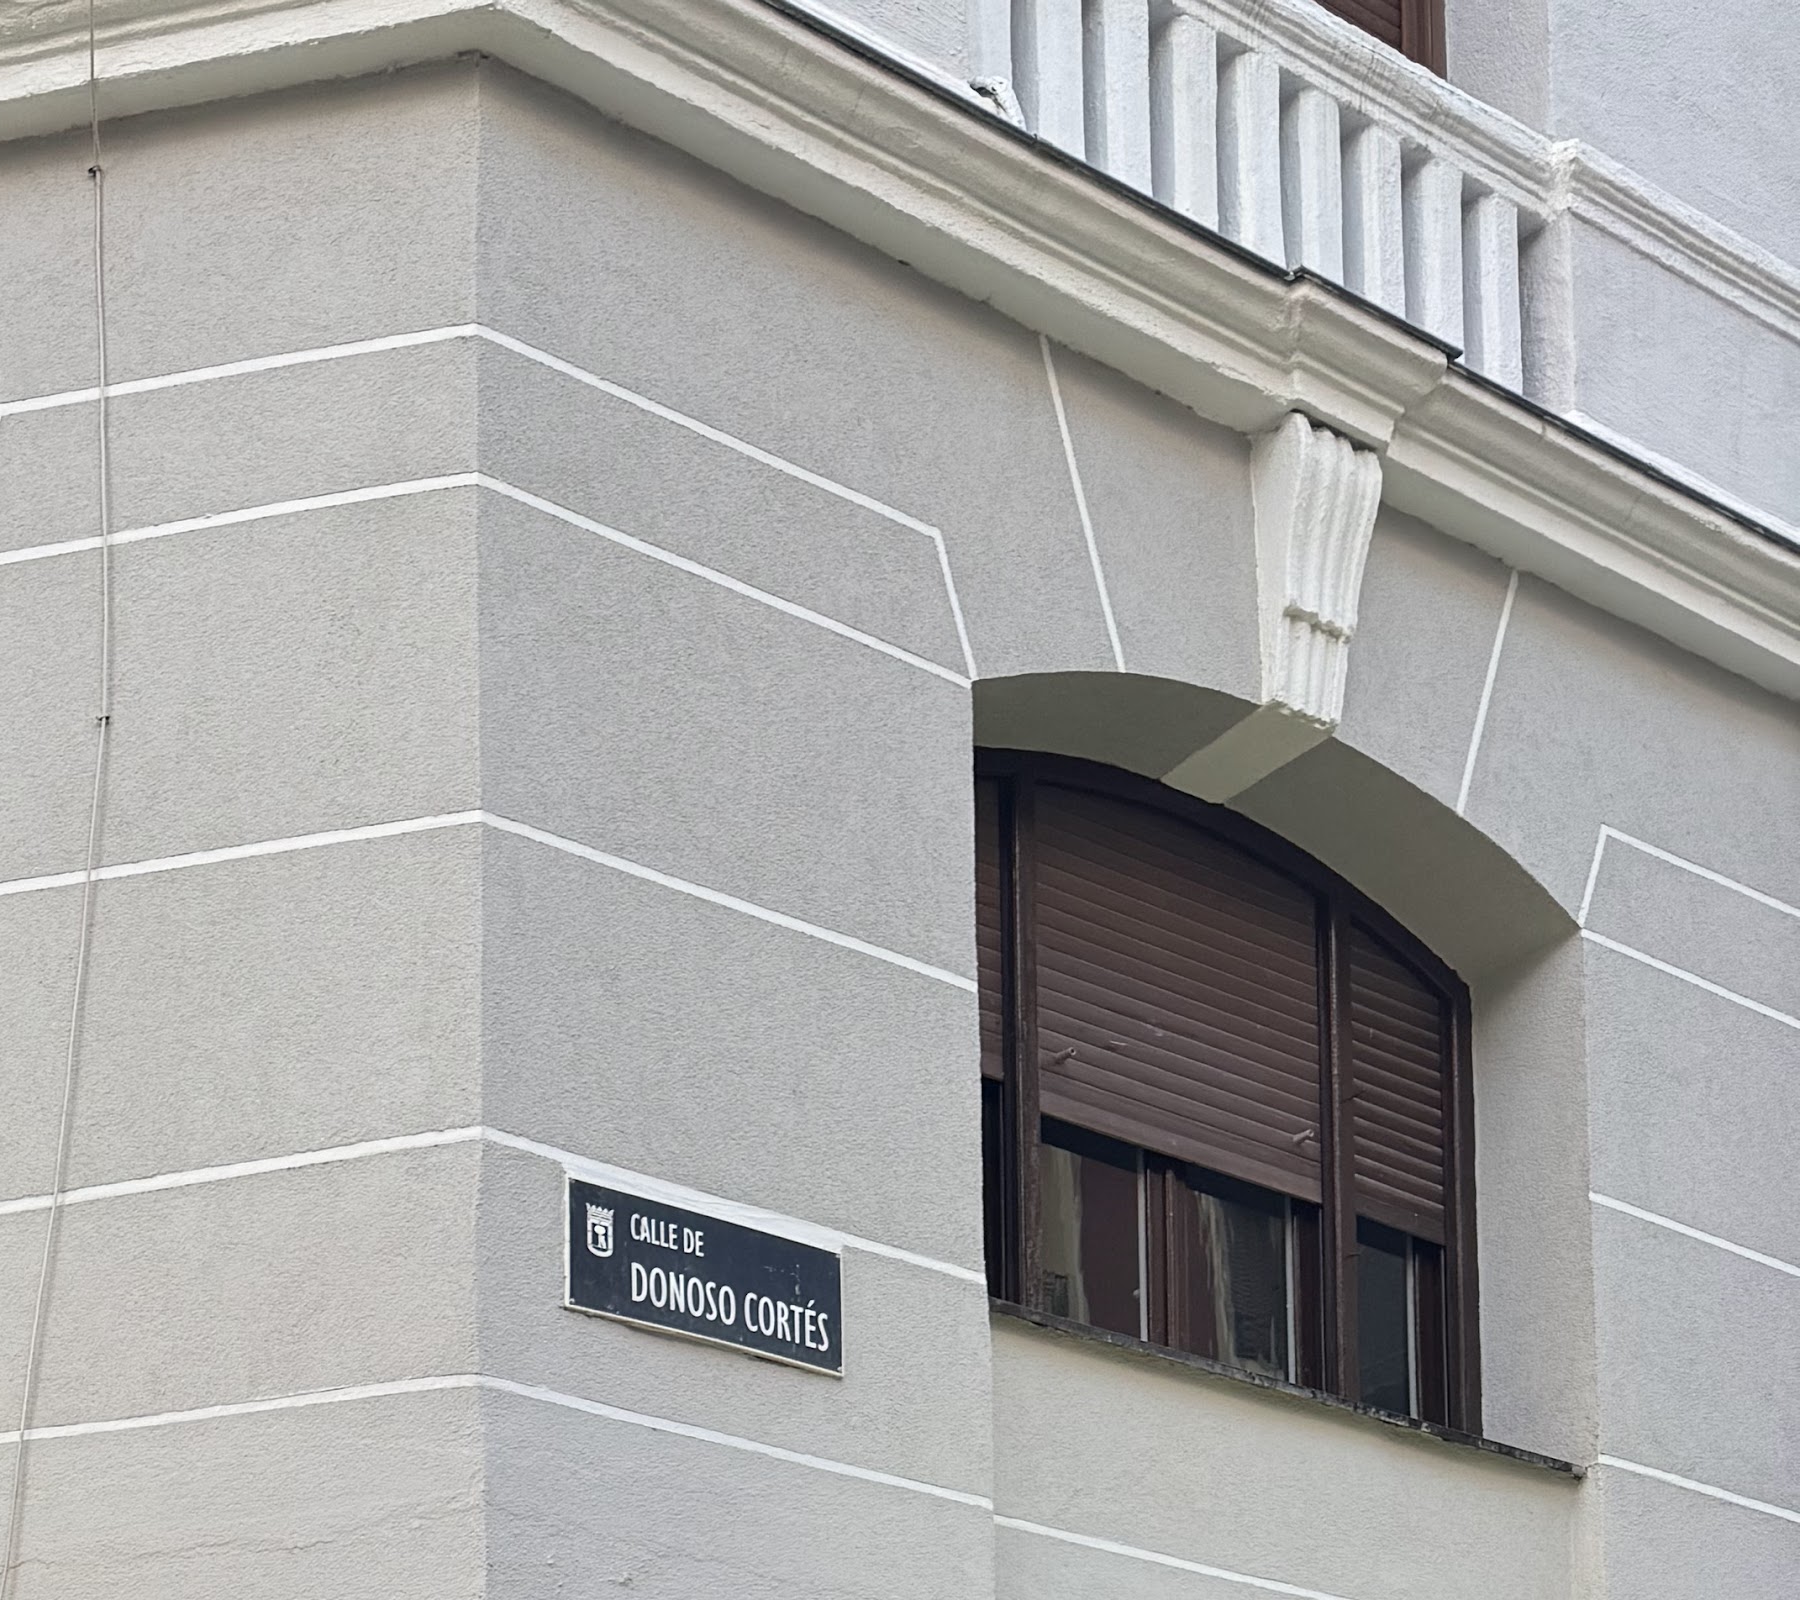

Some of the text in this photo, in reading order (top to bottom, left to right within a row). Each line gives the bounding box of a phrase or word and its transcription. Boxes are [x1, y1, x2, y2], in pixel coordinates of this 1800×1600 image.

[630, 1213, 704, 1257] CALLE DE
[631, 1261, 830, 1352] DONOSO CORTÉS
